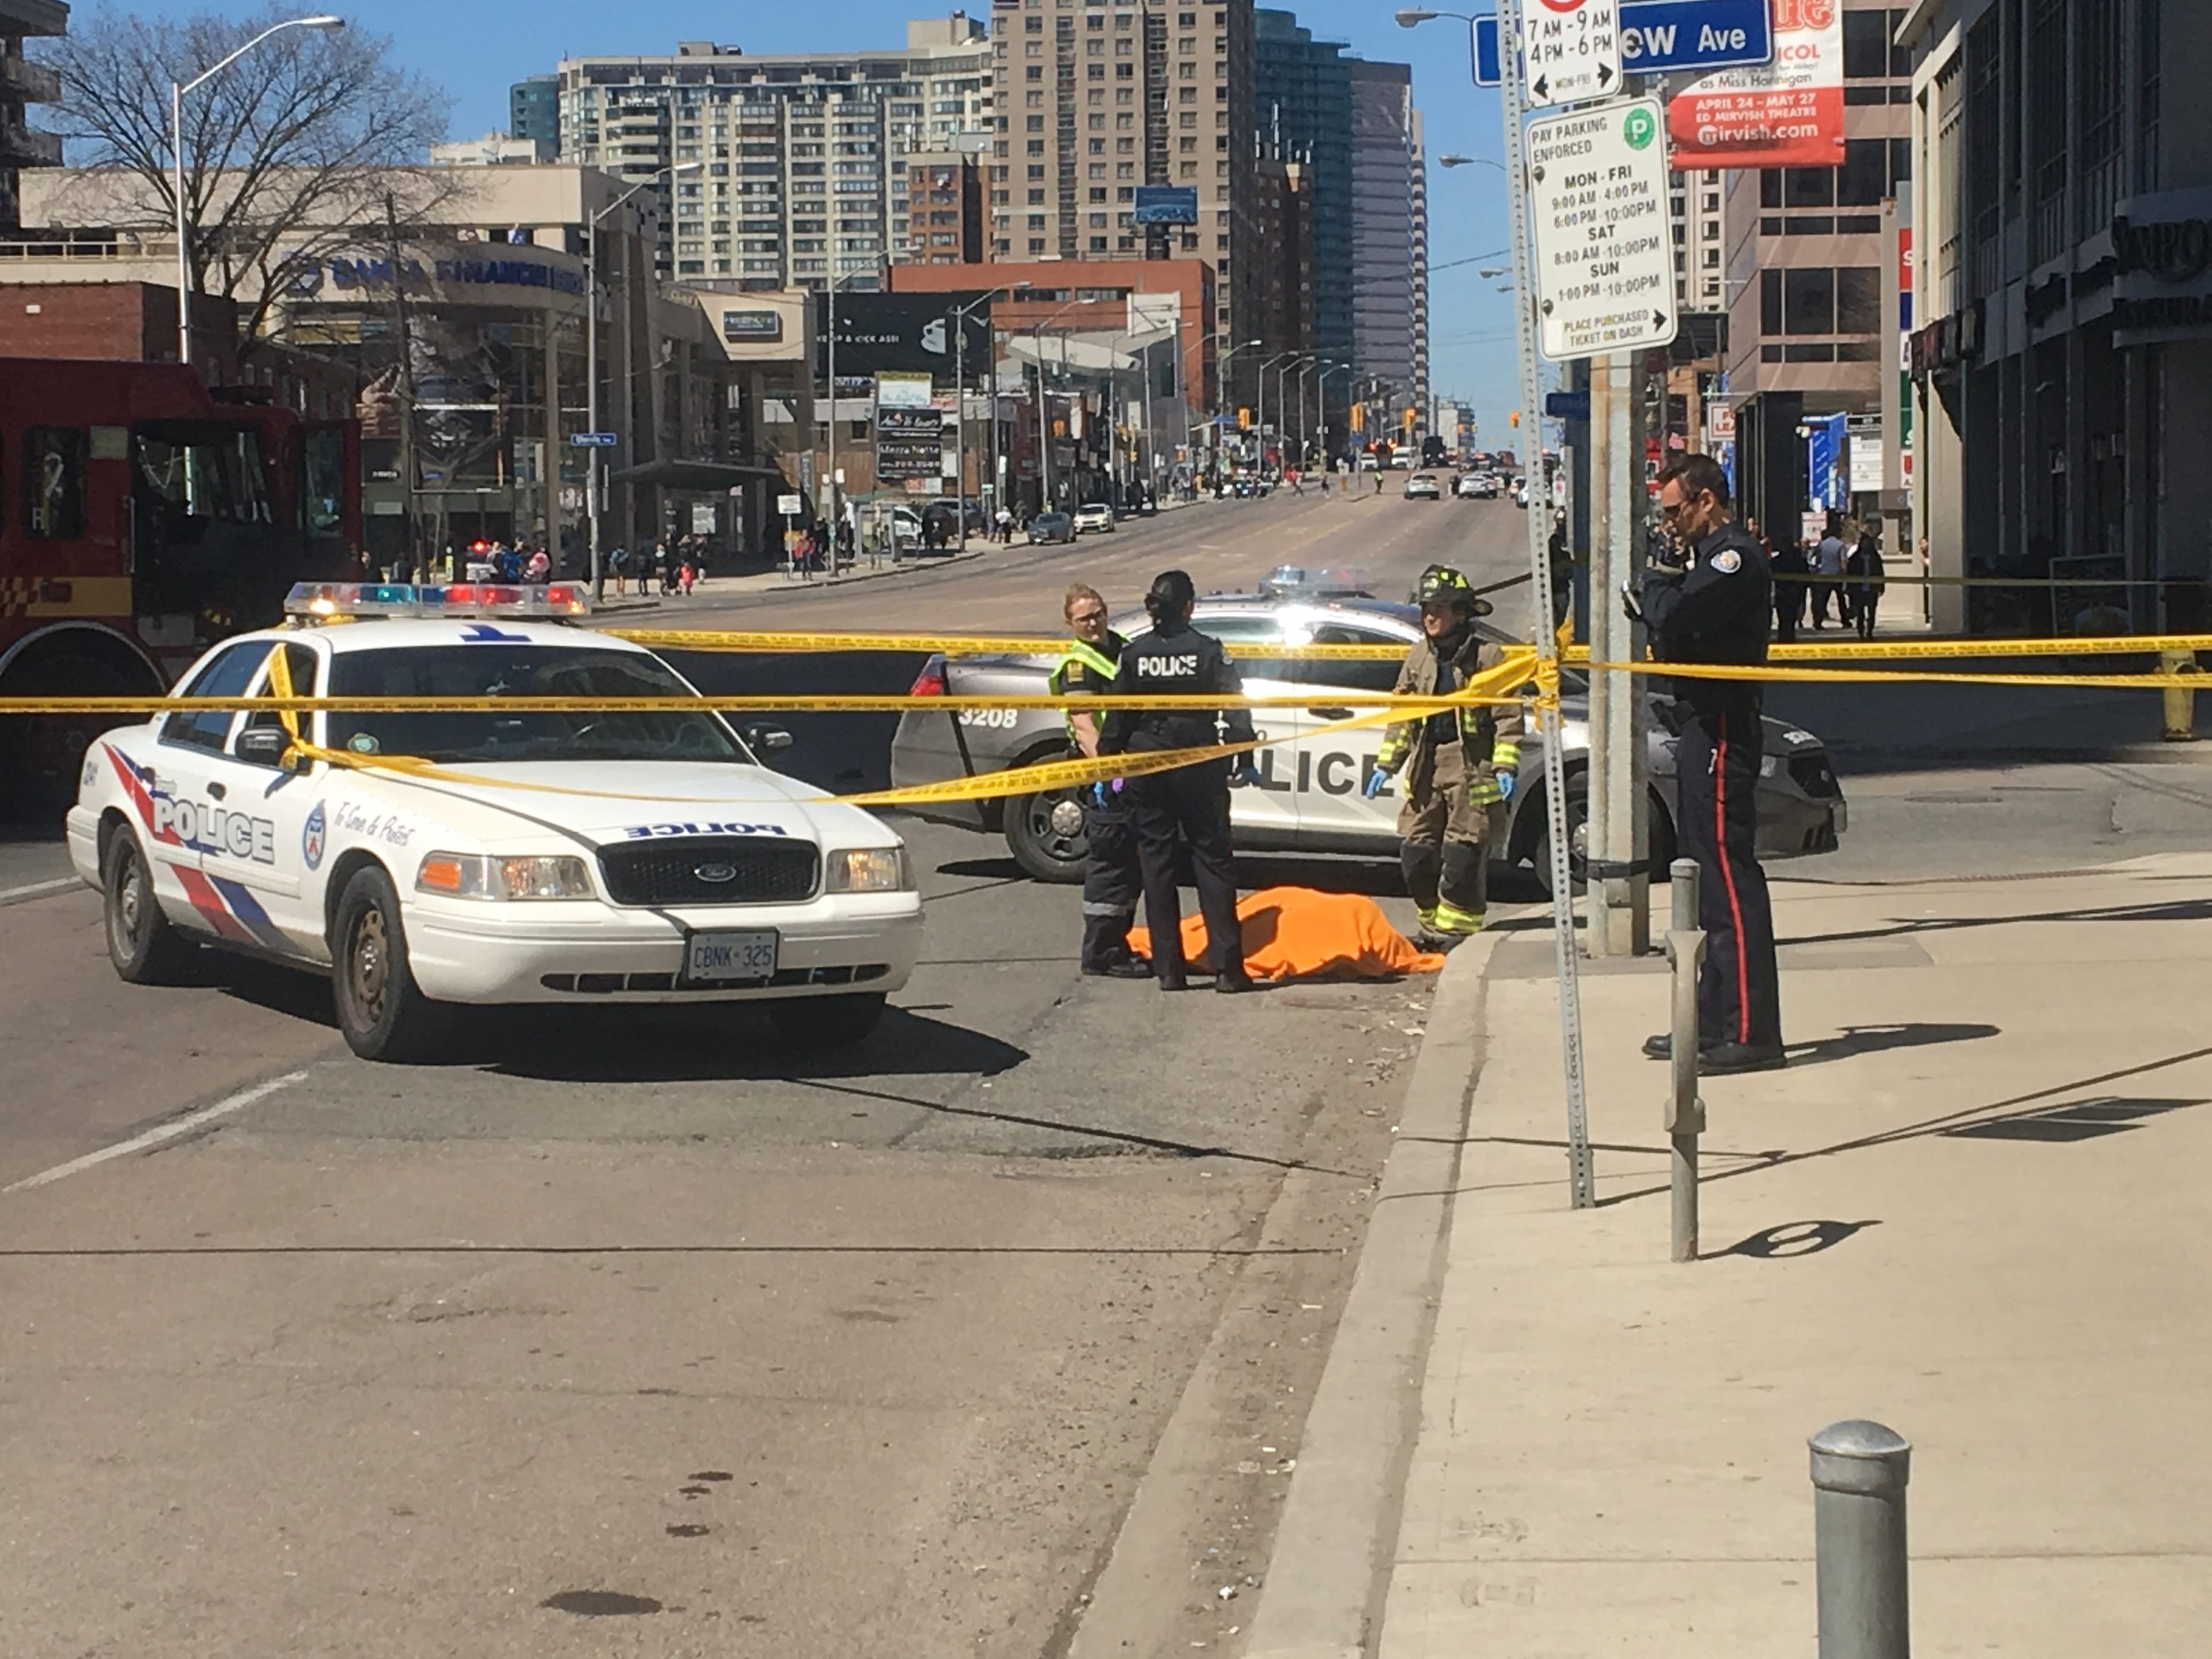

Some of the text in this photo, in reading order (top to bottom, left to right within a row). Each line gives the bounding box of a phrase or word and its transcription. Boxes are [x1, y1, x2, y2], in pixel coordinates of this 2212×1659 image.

[1528, 20, 1537, 40] 7
[1544, 20, 1561, 38] AM
[1577, 10, 1586, 31] 9
[1592, 10, 1610, 29] AM
[1531, 44, 1541, 63] 4
[1545, 44, 1563, 62] PM
[1579, 35, 1588, 55] 6
[1594, 33, 1612, 52] PM
[1698, 24, 1746, 52] Ave
[1777, 44, 1820, 60] ICOL
[1556, 74, 1591, 89] MON-FRI
[1700, 73, 1812, 89] as Miss Hannigan
[1696, 98, 1732, 111] APRIL
[1736, 97, 1753, 108] 24
[1766, 94, 1796, 107] MAY
[1799, 93, 1816, 105] 27
[1696, 107, 1817, 123] ED MIRVISH THEATRE
[1532, 117, 1608, 144] PAY PARKING
[1533, 139, 1592, 163] ENFORCED
[1565, 171, 1597, 189] MON
[1609, 165, 1632, 181] FRI
[1552, 195, 1575, 211] 9:00
[1579, 190, 1596, 204] AM
[1604, 185, 1629, 200] 4:00
[1631, 181, 1649, 196] PM
[1554, 213, 1578, 229] 6:00
[1580, 209, 1597, 226] PM
[1588, 225, 1616, 241] SAT
[1554, 251, 1579, 266] 8:00
[1582, 246, 1600, 260] AM
[1590, 262, 1619, 278] SUN
[1559, 287, 1581, 301] 1:00
[1583, 282, 1600, 297] PM
[1564, 309, 1649, 333] PLACE PURCHASED
[1570, 325, 1643, 346] TICKET ON DASH
[1138, 655, 1198, 677] POLICE
[959, 708, 1018, 728] 3208
[1227, 748, 1395, 797] LICE
[153, 796, 275, 865] POLICE
[694, 945, 772, 968] CBNK 325
